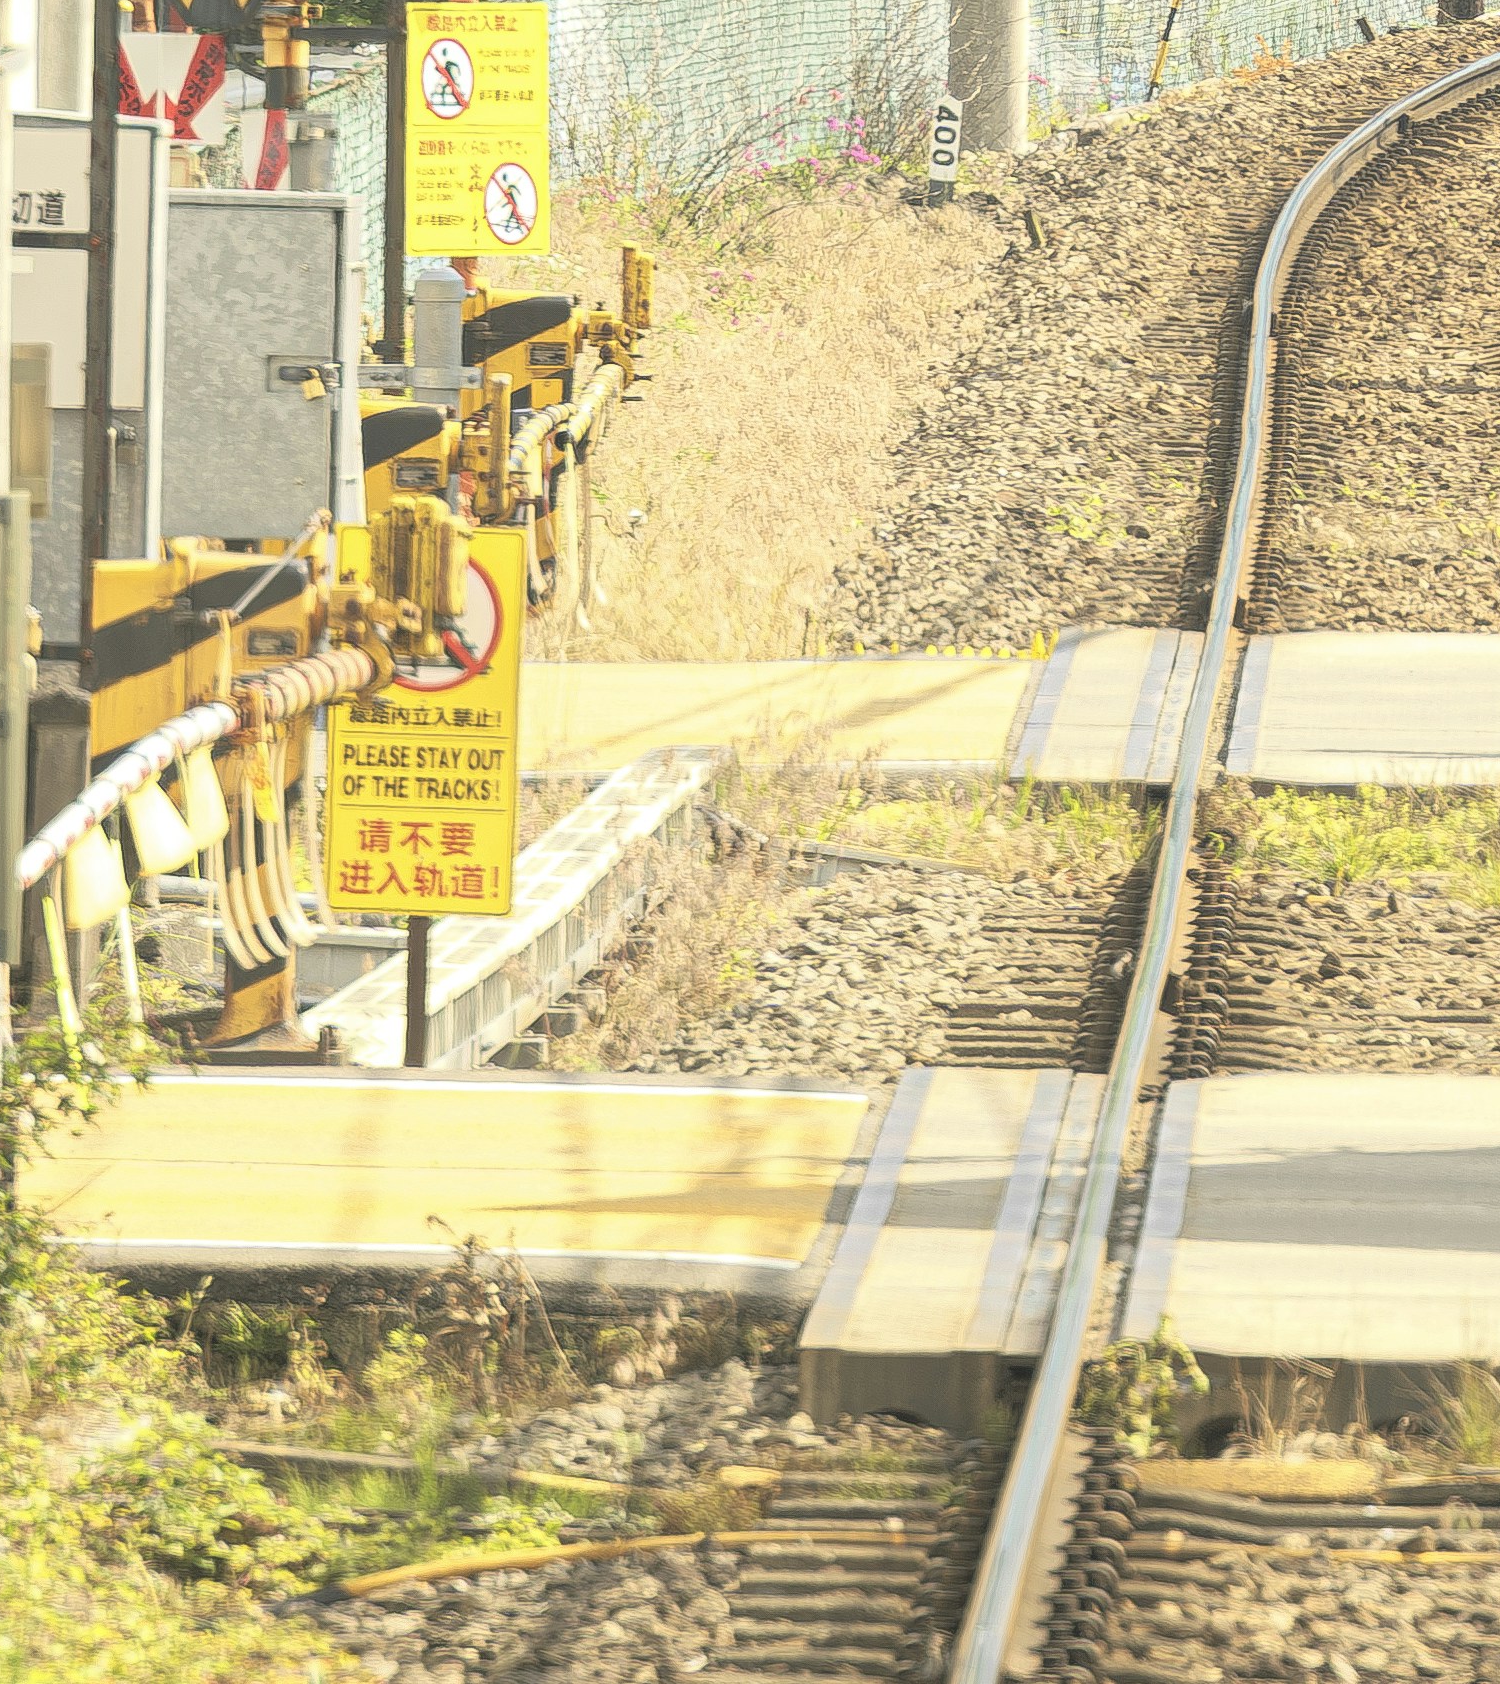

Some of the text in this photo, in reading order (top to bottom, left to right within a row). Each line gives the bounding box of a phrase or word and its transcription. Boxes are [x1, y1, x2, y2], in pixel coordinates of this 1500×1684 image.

[933, 105, 959, 166] 400
[343, 743, 505, 771] PLEASE STAY OUT
[342, 774, 500, 802] OF THE TRACKS!
[358, 818, 476, 856] 请不要
[338, 859, 500, 899] 进入轨道!
